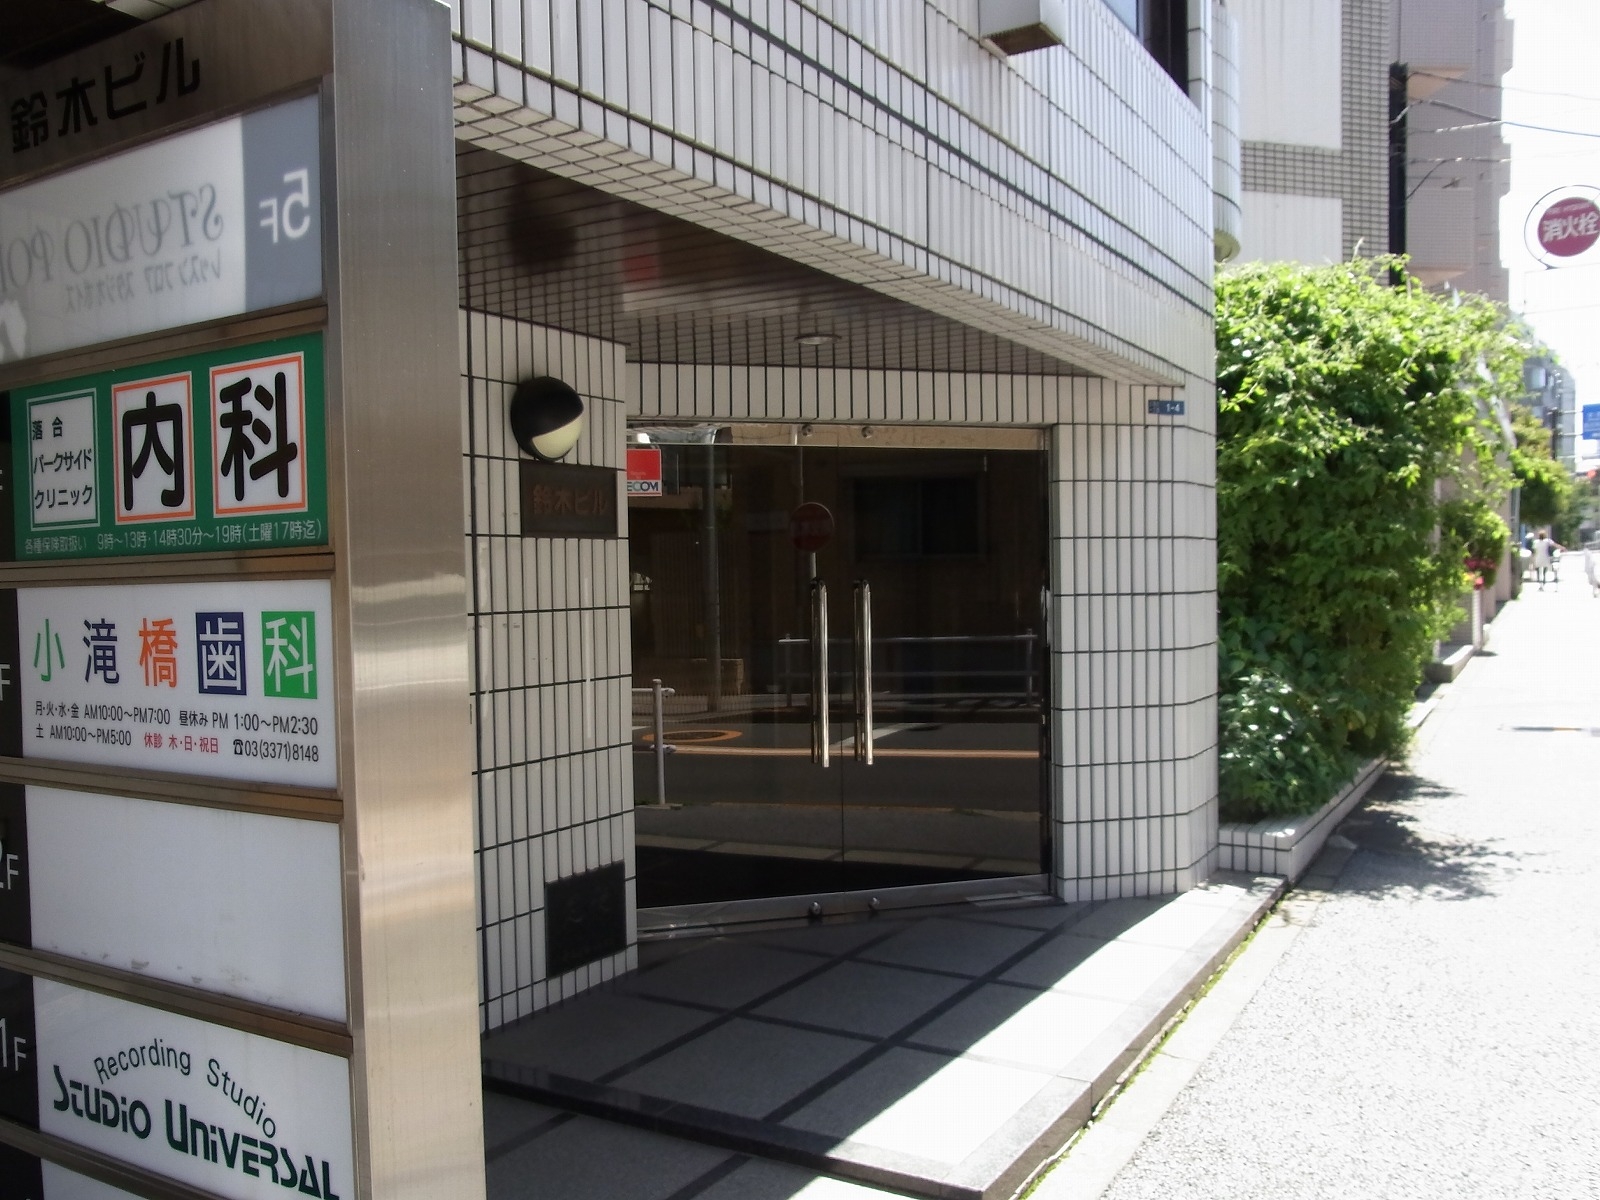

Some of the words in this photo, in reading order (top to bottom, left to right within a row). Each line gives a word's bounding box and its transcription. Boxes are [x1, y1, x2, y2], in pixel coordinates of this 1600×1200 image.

[10, 37, 200, 153] 鈴木ビル
[1543, 211, 1600, 243] 消火栓
[122, 372, 298, 510] 内科
[33, 448, 92, 474] パークサイド
[34, 485, 93, 509] クリニック
[533, 484, 608, 515] 鈴木ビル
[34, 617, 313, 693] 小滝橋歯科
[179, 710, 208, 727] 昼休み
[36, 723, 44, 738] 土
[144, 732, 163, 749] 休診
[245, 739, 319, 762] 03(3371)8148
[0, 1017, 26, 1071] 1F
[94, 1038, 191, 1085] Recording
[207, 1058, 276, 1138] Studio
